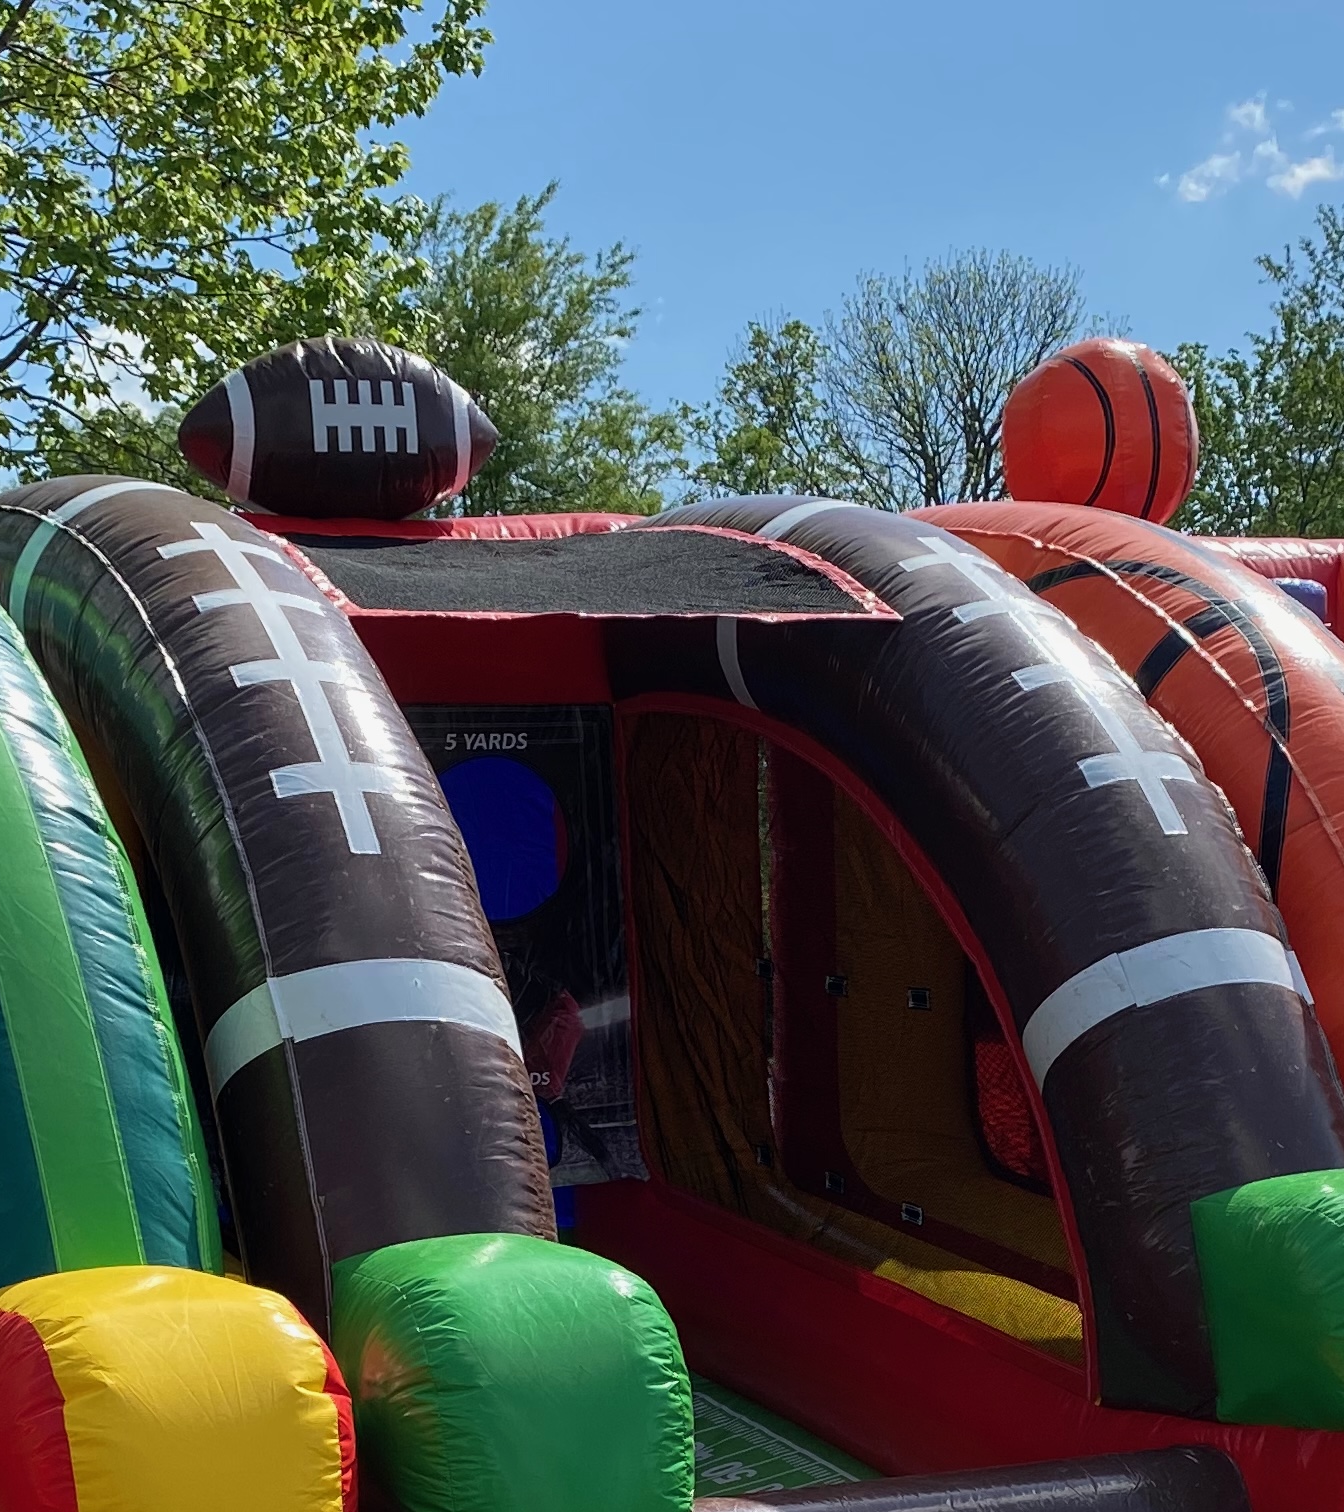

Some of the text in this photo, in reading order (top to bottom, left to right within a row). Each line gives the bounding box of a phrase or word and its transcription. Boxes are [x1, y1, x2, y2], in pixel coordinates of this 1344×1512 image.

[444, 732, 528, 751] 5 YARDS
[701, 1461, 758, 1485] 50
